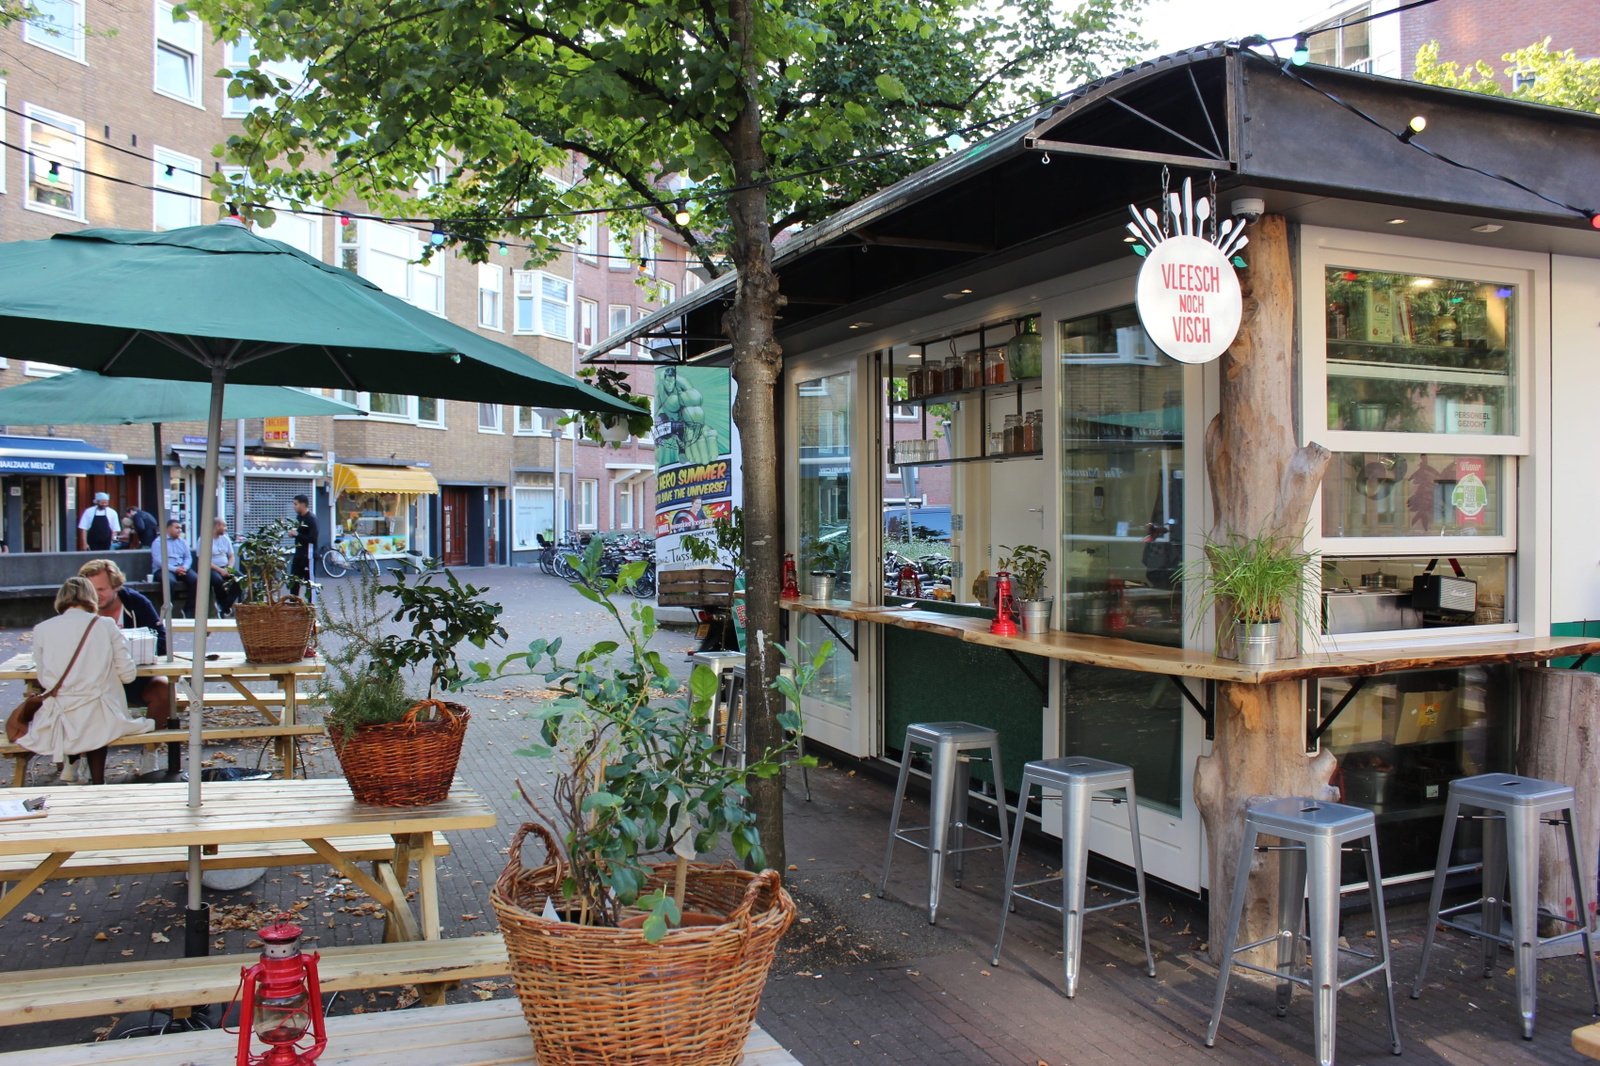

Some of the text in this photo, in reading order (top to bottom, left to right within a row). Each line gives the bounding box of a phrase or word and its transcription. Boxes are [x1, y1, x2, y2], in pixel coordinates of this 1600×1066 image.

[1161, 263, 1220, 294] VLEESCH
[1179, 294, 1205, 314] NOCH
[1172, 316, 1211, 344] VISCH
[1454, 411, 1491, 420] PERSONEEL
[1458, 420, 1487, 428] GEZOCHT
[659, 471, 676, 490] HERO
[678, 462, 727, 485] SUMMER
[674, 487, 686, 499] THE
[687, 480, 727, 497] UNIVERSE!
